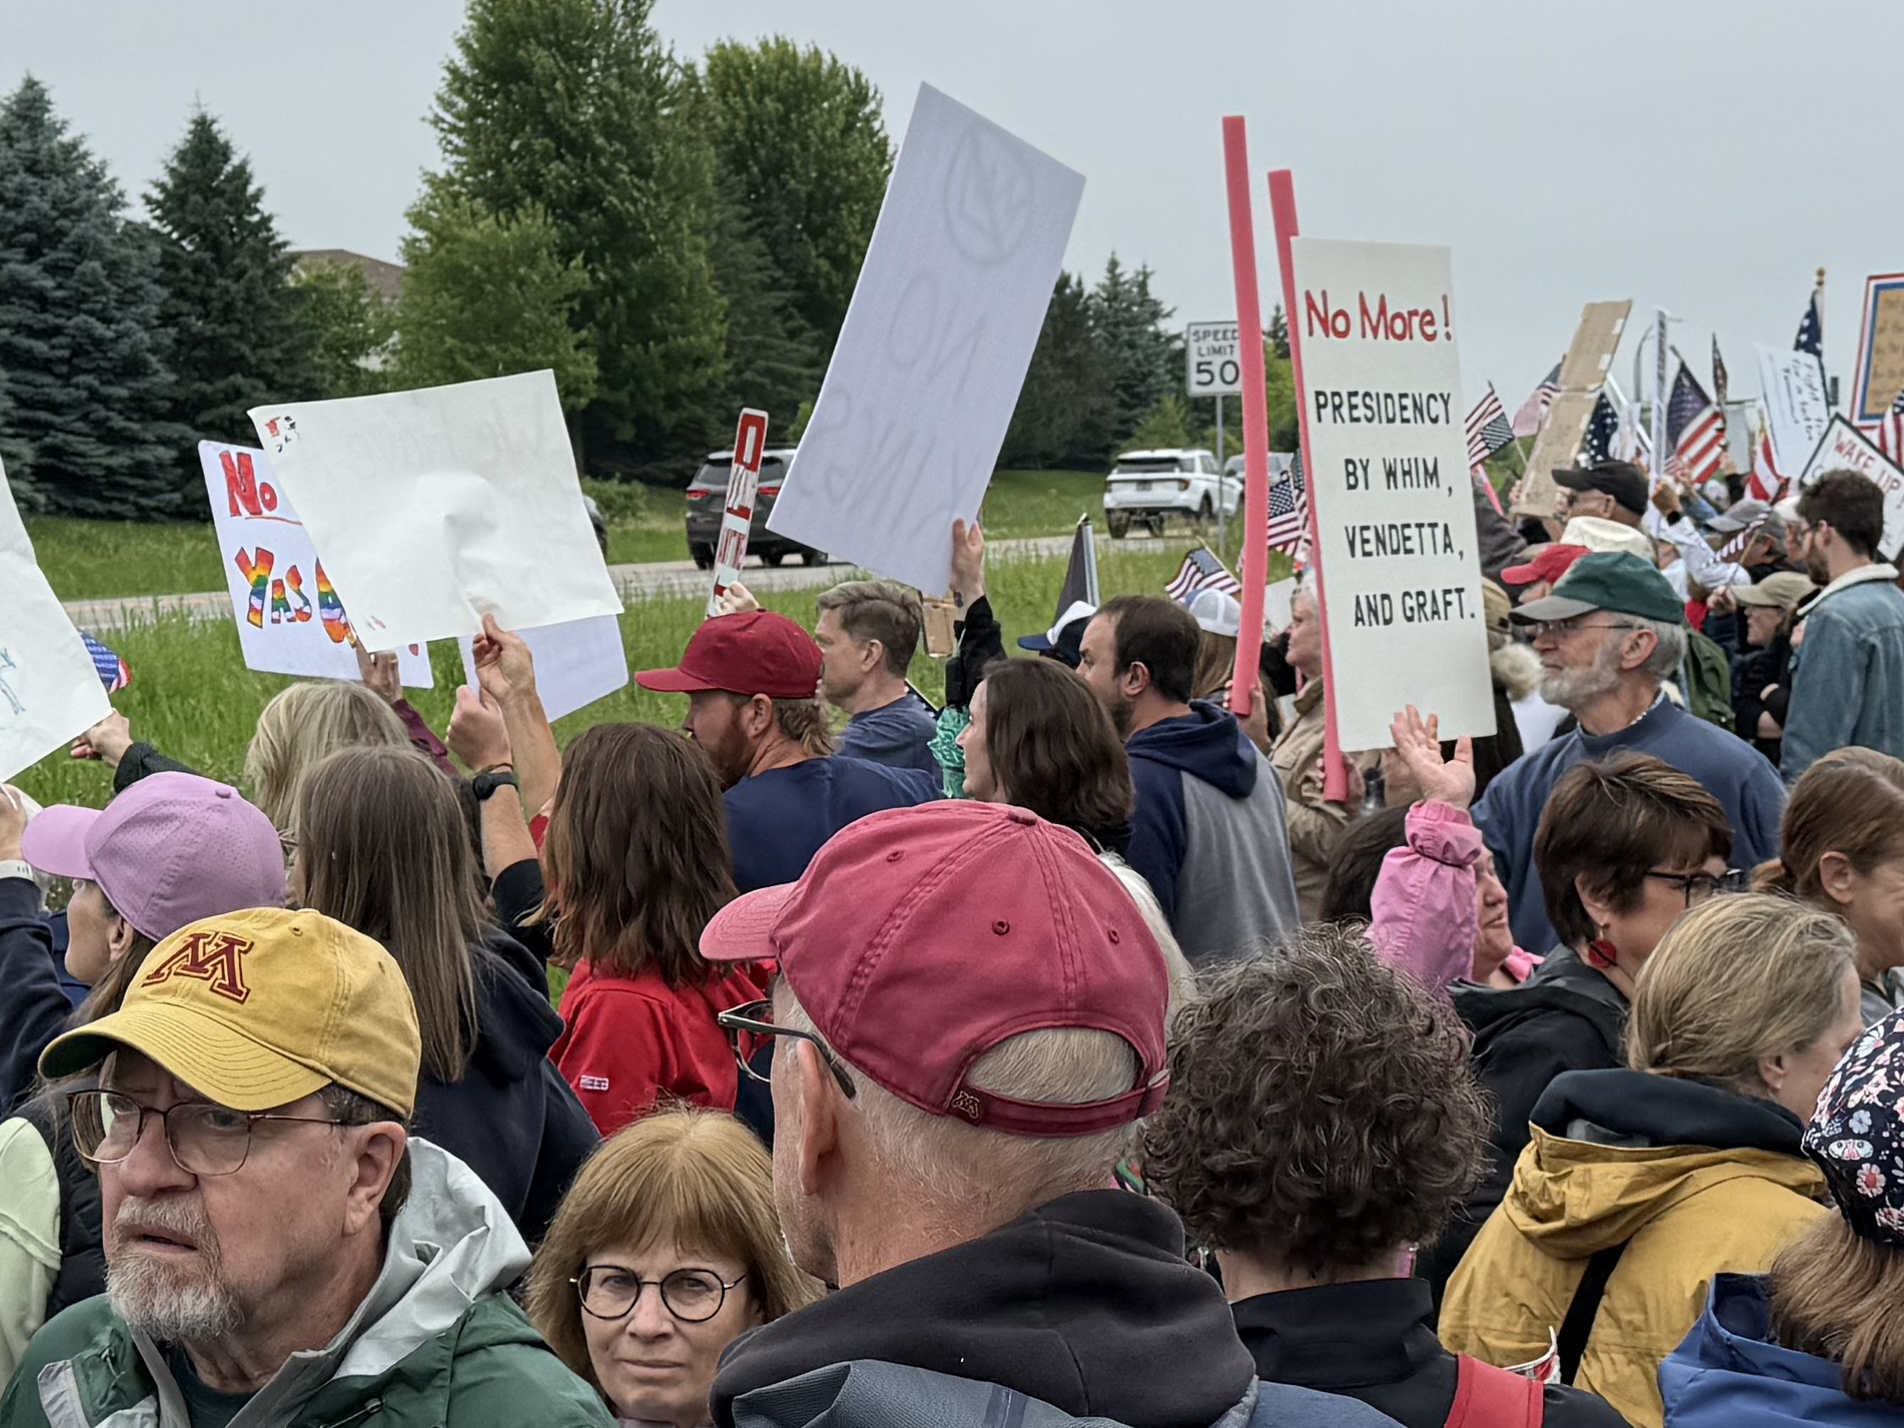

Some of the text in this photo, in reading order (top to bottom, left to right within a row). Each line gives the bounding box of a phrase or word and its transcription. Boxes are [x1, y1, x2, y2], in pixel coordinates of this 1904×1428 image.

[1304, 289, 1351, 339] No
[1197, 344, 1235, 358] LIMIT
[1196, 359, 1240, 387] 50
[1314, 389, 1452, 426] PRESIDENCY
[1344, 458, 1370, 491] BY
[1344, 522, 1464, 561] VENDETTA,
[1354, 587, 1475, 627] AND GRAFT.
[141, 930, 255, 1005] M
